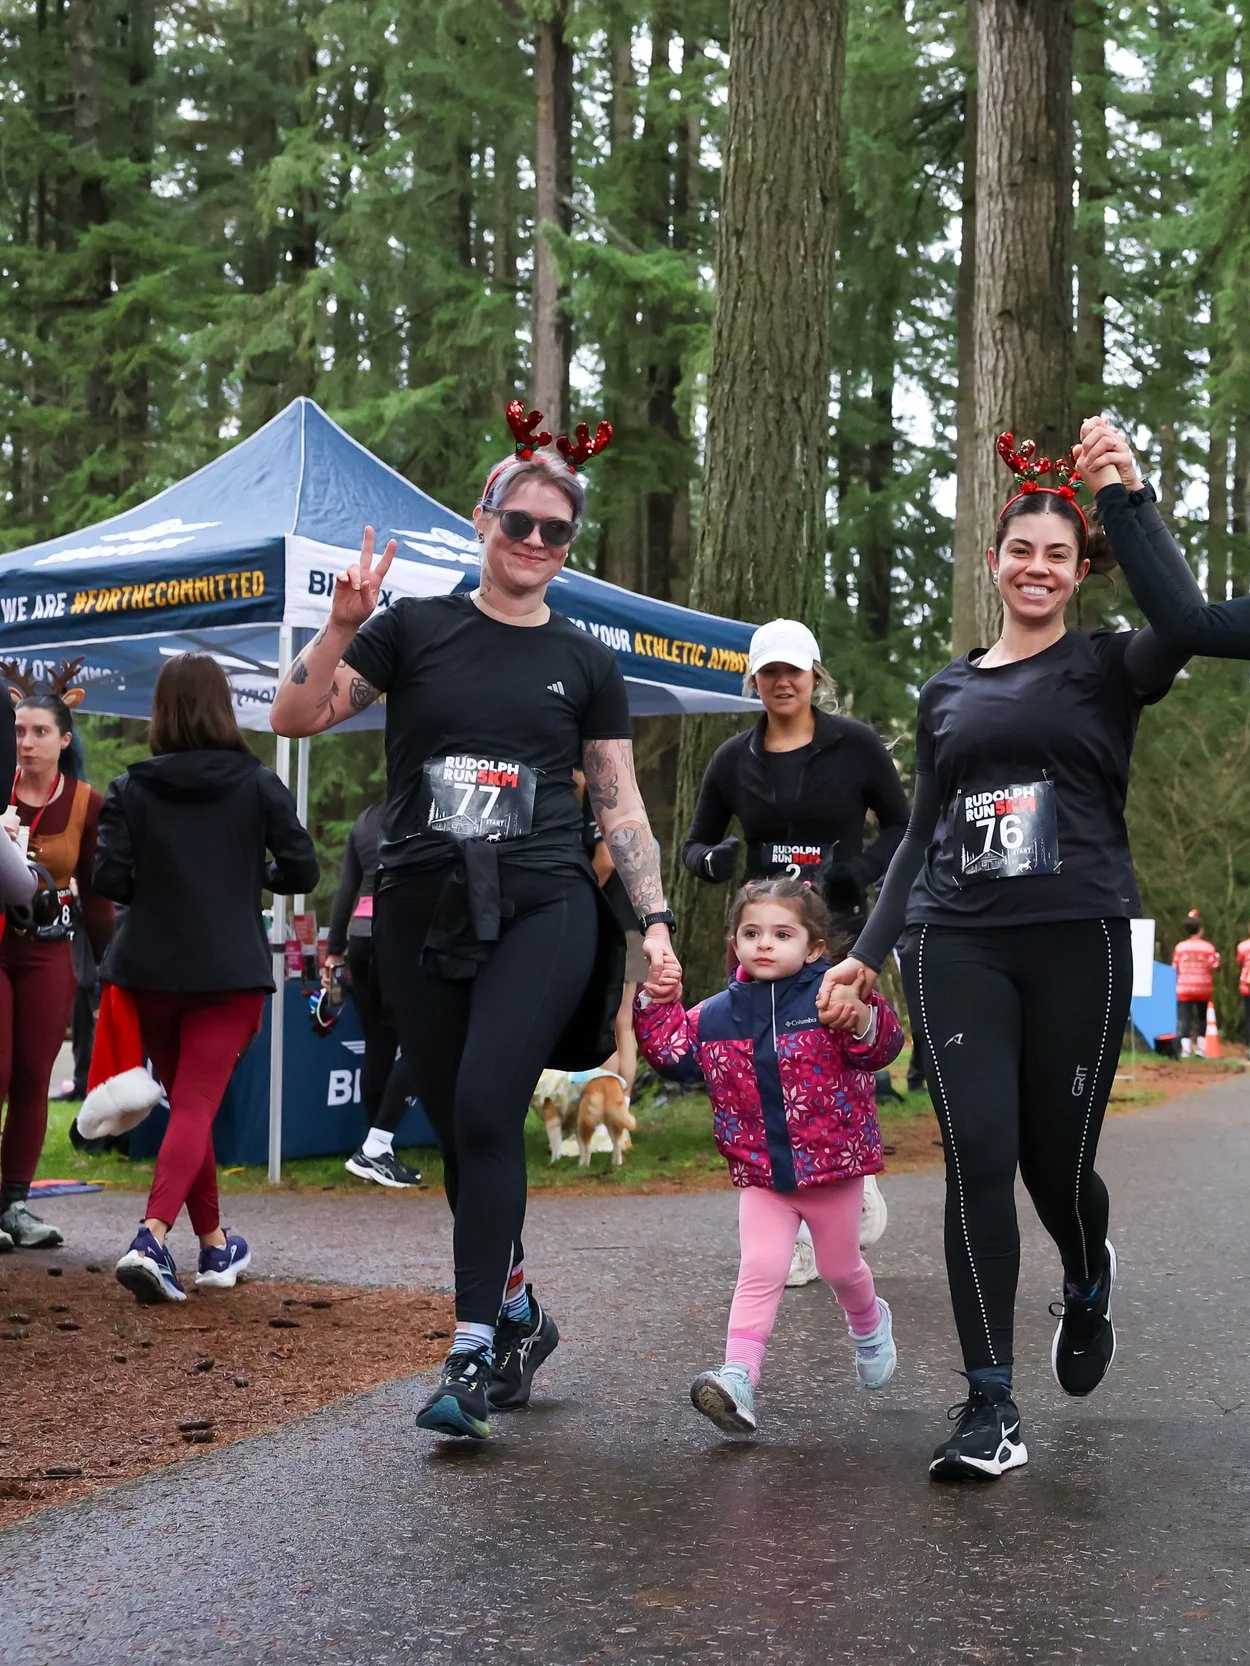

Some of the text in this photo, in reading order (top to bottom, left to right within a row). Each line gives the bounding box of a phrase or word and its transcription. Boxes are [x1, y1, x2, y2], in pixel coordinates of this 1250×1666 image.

[1, 570, 265, 624] WE ARE #FORTHECOMMITTED
[589, 622, 632, 652] YOUR
[634, 632, 707, 667] ATHLETIC
[444, 756, 519, 775] RUDOLPH
[453, 782, 501, 819] 77
[965, 786, 1035, 810] RUDOLPH
[976, 814, 1024, 853] 76
[772, 845, 821, 855] RUDOLPH
[785, 864, 801, 882] 2
[791, 1017, 817, 1026] Columbia
[1071, 1064, 1088, 1097] GRIT
